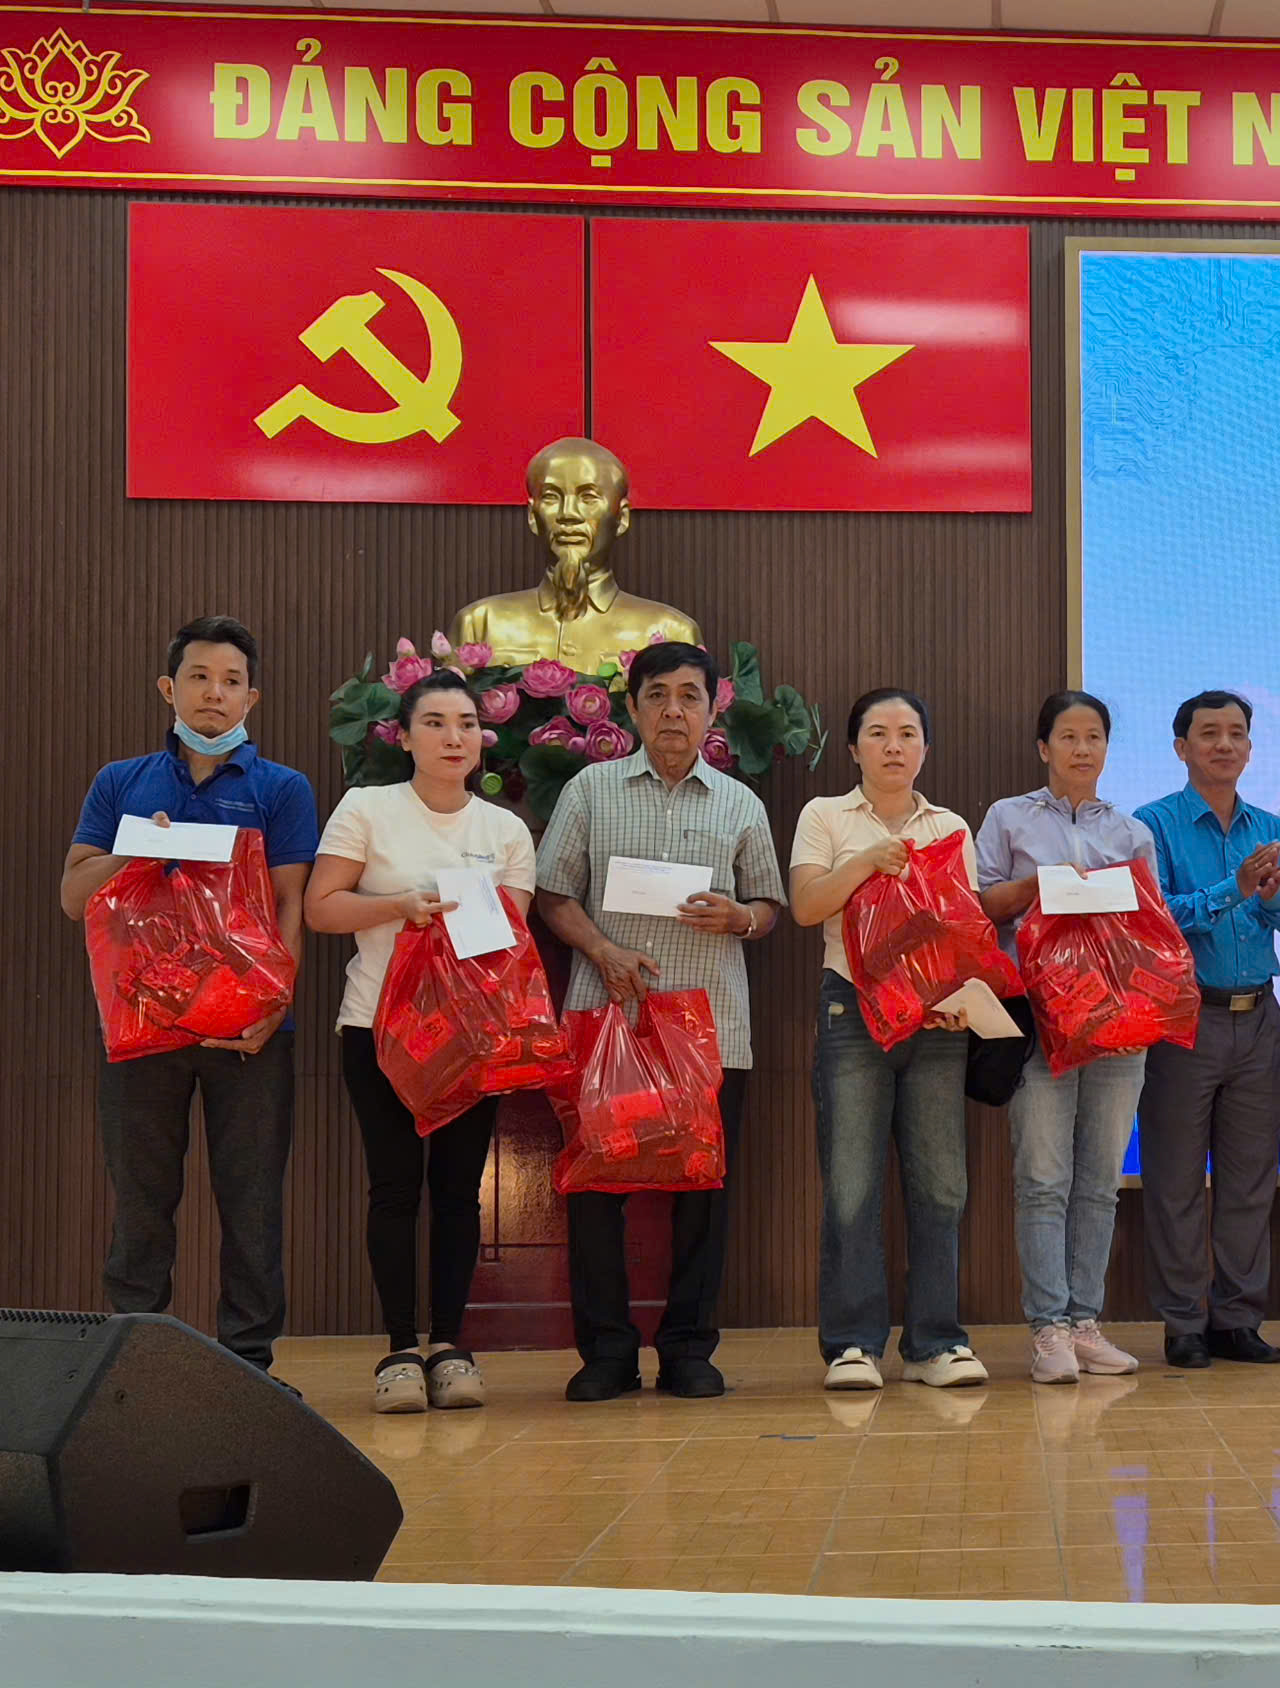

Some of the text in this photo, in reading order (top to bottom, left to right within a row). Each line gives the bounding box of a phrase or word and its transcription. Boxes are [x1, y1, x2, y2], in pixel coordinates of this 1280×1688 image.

[211, 37, 472, 145] ĐẢNG
[510, 57, 761, 167] CỘNG
[796, 56, 982, 160] SẢN
[1013, 72, 1200, 181] VIỆT
